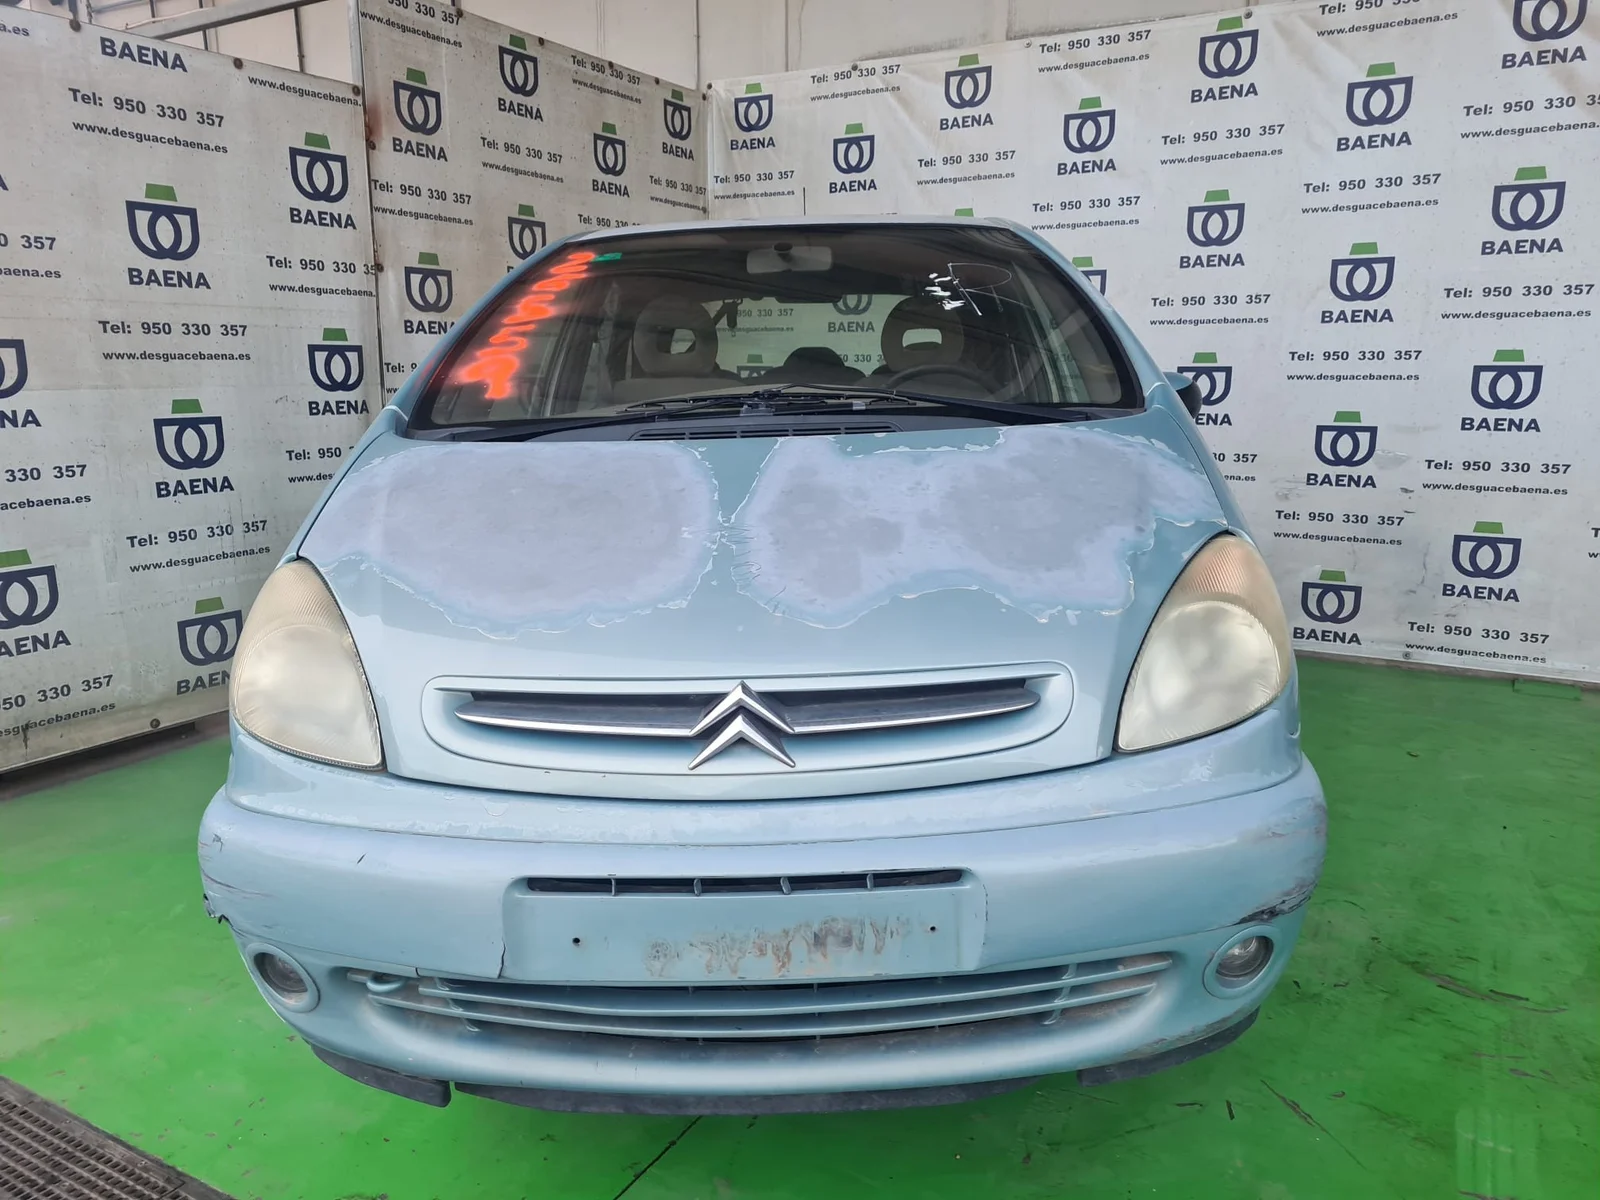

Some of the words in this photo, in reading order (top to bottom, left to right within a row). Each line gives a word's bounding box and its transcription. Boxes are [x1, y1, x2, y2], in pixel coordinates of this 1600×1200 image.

[414, 1, 436, 19] 330
[441, 9, 460, 26] 357
[1318, 2, 1347, 16] Tel:
[1355, 0, 1384, 11] 950
[360, 10, 463, 49] www.desguacebaena.es
[1316, 12, 1458, 37] www.desguacebaena.es
[1039, 42, 1061, 54] Tel:
[1067, 37, 1091, 51] 950
[1097, 33, 1121, 47] 330
[1127, 29, 1152, 43] 357
[99, 36, 188, 73] BAENA
[1037, 53, 1150, 73] www.desguacebaena.es
[1501, 45, 1587, 70] BAENA
[570, 54, 587, 69] Tel:
[590, 60, 606, 75] 950
[608, 67, 624, 81] 330
[626, 73, 641, 86] 357
[810, 73, 829, 85] Tel:
[833, 69, 853, 81] 950
[857, 66, 877, 78] 330
[881, 63, 901, 76] 357
[809, 85, 901, 102] www.desguacebaena.es
[1190, 82, 1259, 104] BAENA
[67, 87, 104, 107] Tel:
[112, 96, 147, 115] 950
[155, 104, 188, 122] 330
[195, 111, 225, 128] 357
[497, 97, 544, 123] BAENA
[1462, 103, 1494, 117] Tel:
[1502, 99, 1534, 114] 950
[1543, 95, 1577, 110] 330
[939, 112, 994, 131] BAENA
[1460, 121, 1600, 139] www.desguacebaena.
[72, 121, 229, 154] www.desguacebaena.es
[730, 136, 776, 151] BAENA
[1161, 133, 1186, 146] Tel:
[1192, 130, 1218, 143] 950
[1225, 127, 1251, 140] 330
[1258, 123, 1285, 137] 357
[1336, 131, 1412, 152] BAENA
[392, 136, 449, 163] BAENA
[479, 136, 499, 151] Tel:
[503, 141, 521, 156] 950
[525, 146, 543, 160] 330
[547, 151, 563, 165] 357
[661, 141, 695, 162] BAENA
[917, 157, 937, 168] Tel:
[941, 154, 963, 166] 950
[968, 152, 989, 164] 330
[995, 149, 1016, 161] 357
[1159, 148, 1283, 166] www.desguacebaena.es
[481, 161, 564, 184] www.desguacebaena.es
[1057, 158, 1117, 176] BAENA
[648, 174, 663, 186] Tel:
[665, 178, 678, 190] 950
[680, 182, 694, 193] 330
[713, 174, 731, 184] Tel:
[733, 173, 751, 183] 950
[756, 171, 774, 182] 330
[777, 170, 795, 181] 357
[829, 178, 878, 194] BAENA
[916, 172, 1016, 186] www.desguacebaena.es
[1303, 181, 1330, 194] Tel:
[1338, 178, 1366, 191] 950
[1374, 175, 1404, 189] 330
[1411, 172, 1442, 186] 357
[370, 179, 394, 193] Tel:
[399, 183, 422, 198] 950
[427, 187, 447, 202] 330
[452, 192, 472, 205] 357
[591, 178, 631, 199] BAENA
[713, 189, 796, 201] www.desguacebaena.es
[1032, 202, 1054, 213] Tel:
[1059, 199, 1082, 211] 950
[1088, 197, 1111, 209] 330
[1117, 195, 1141, 207] 357
[1301, 198, 1439, 215] www.desguacebaena.es
[289, 206, 358, 231] BAENA
[372, 204, 474, 226] www.desguacebaena.es
[577, 213, 593, 226] Tel:
[595, 217, 612, 228] 950
[1031, 218, 1140, 232] www.desguacebaena.es
[20, 234, 57, 251] 357
[1480, 237, 1564, 256] BAENA
[265, 255, 293, 269] Tel:
[299, 258, 325, 272] 950
[332, 260, 357, 274] 330
[1179, 252, 1245, 269] BAENA
[127, 267, 212, 290] BAENA
[268, 283, 376, 298] www.desguacebaena.
[1150, 296, 1175, 307] Tel:
[1181, 295, 1206, 307] 950
[1213, 294, 1238, 306] 330
[1245, 293, 1271, 305] 357
[1443, 287, 1473, 299] Tel:
[1482, 285, 1513, 298] 950
[1521, 284, 1553, 297] 330
[1562, 283, 1595, 296] 357
[1149, 316, 1269, 327] www.desguacebaena.es
[1320, 308, 1394, 324] BAENA
[1440, 309, 1592, 321] www.desguacebaena.es
[97, 320, 132, 335] Tel:
[140, 321, 172, 336] 950
[181, 322, 211, 336] 330
[219, 323, 248, 337] 357
[403, 319, 455, 335] BAEN
[827, 320, 876, 333] BAENA
[102, 350, 252, 363] www.desguacebaena.es
[1288, 351, 1315, 362] Tel:
[1322, 350, 1350, 362] 950
[1357, 350, 1386, 361] 330
[1393, 349, 1423, 361] 357
[383, 362, 405, 373] Tel:
[1286, 372, 1420, 383] www.desguacebaena.es
[307, 399, 370, 417] BAENA
[1460, 416, 1541, 433] BAENA
[285, 448, 311, 462] Tel:
[317, 446, 342, 459] 950
[1232, 453, 1258, 464] 357
[4, 467, 42, 483] 330
[52, 463, 87, 479] 357
[1424, 459, 1453, 471] Tel:
[1462, 460, 1492, 472] 950
[1500, 461, 1531, 473] 330
[1540, 463, 1572, 475] 357
[155, 475, 235, 499] BAENA
[1305, 472, 1377, 489] BAENA
[1421, 482, 1568, 496] www.desguacebaena.es
[1275, 509, 1301, 521] Tel:
[1308, 511, 1334, 523] 950
[1342, 513, 1369, 525] 330
[1377, 515, 1405, 527] 357
[125, 533, 159, 549] Tel:
[167, 528, 198, 544] 950
[206, 523, 235, 539] 330
[242, 519, 268, 534] 357
[1273, 531, 1403, 546] www.desguacebaena.es
[129, 545, 271, 573] www.desguacebaena.es
[1441, 582, 1520, 603] BAENA
[1292, 626, 1362, 646] BAENA
[1407, 621, 1435, 634] Tel:
[1443, 624, 1473, 637] 950
[1481, 628, 1511, 641] 330
[1519, 632, 1550, 645] 357
[1404, 642, 1547, 664] www.desguacebaena.es
[36, 683, 72, 703] 330
[81, 674, 114, 693] 357
[176, 669, 231, 697] BAEN
